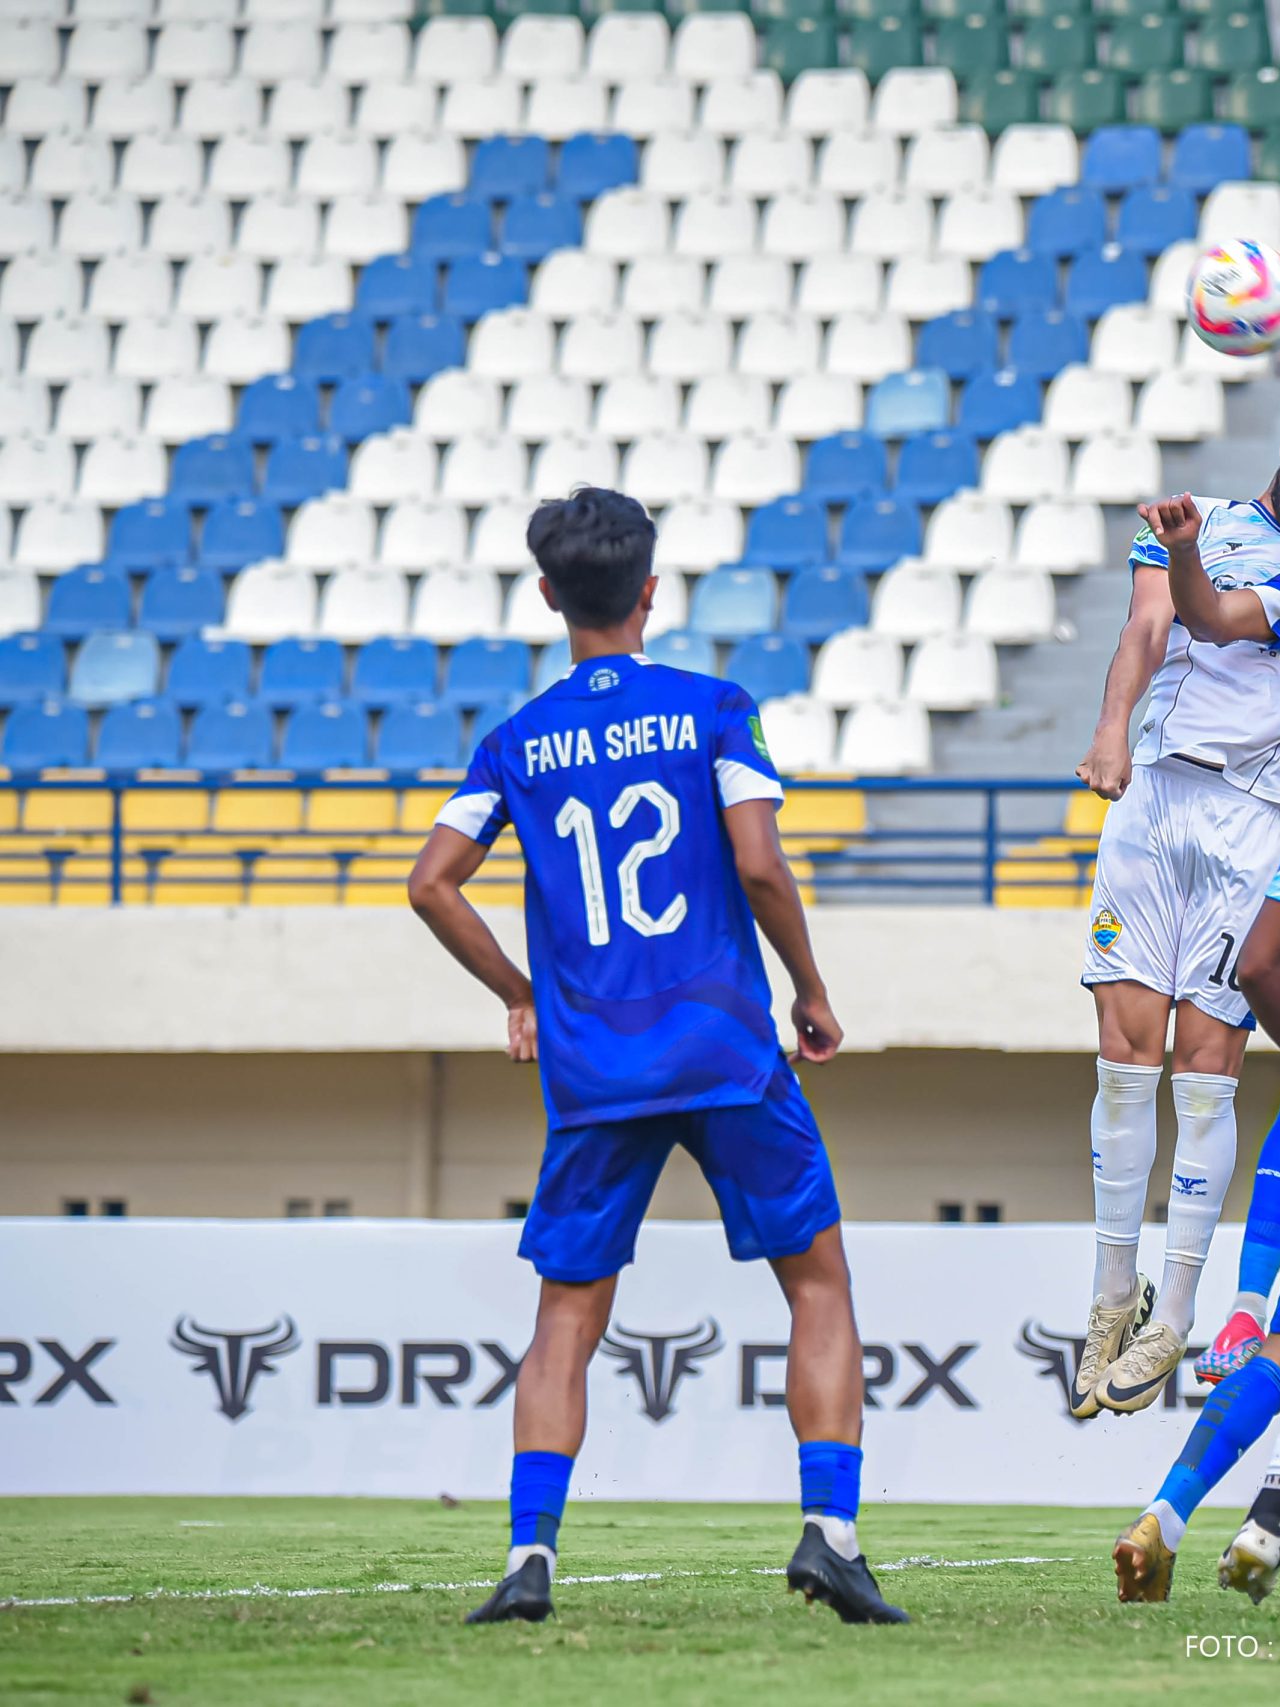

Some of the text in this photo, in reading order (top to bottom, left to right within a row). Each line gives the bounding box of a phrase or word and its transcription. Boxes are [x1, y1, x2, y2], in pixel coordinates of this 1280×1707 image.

[524, 714, 698, 777] FAVA SHEVA
[555, 780, 688, 947] 12
